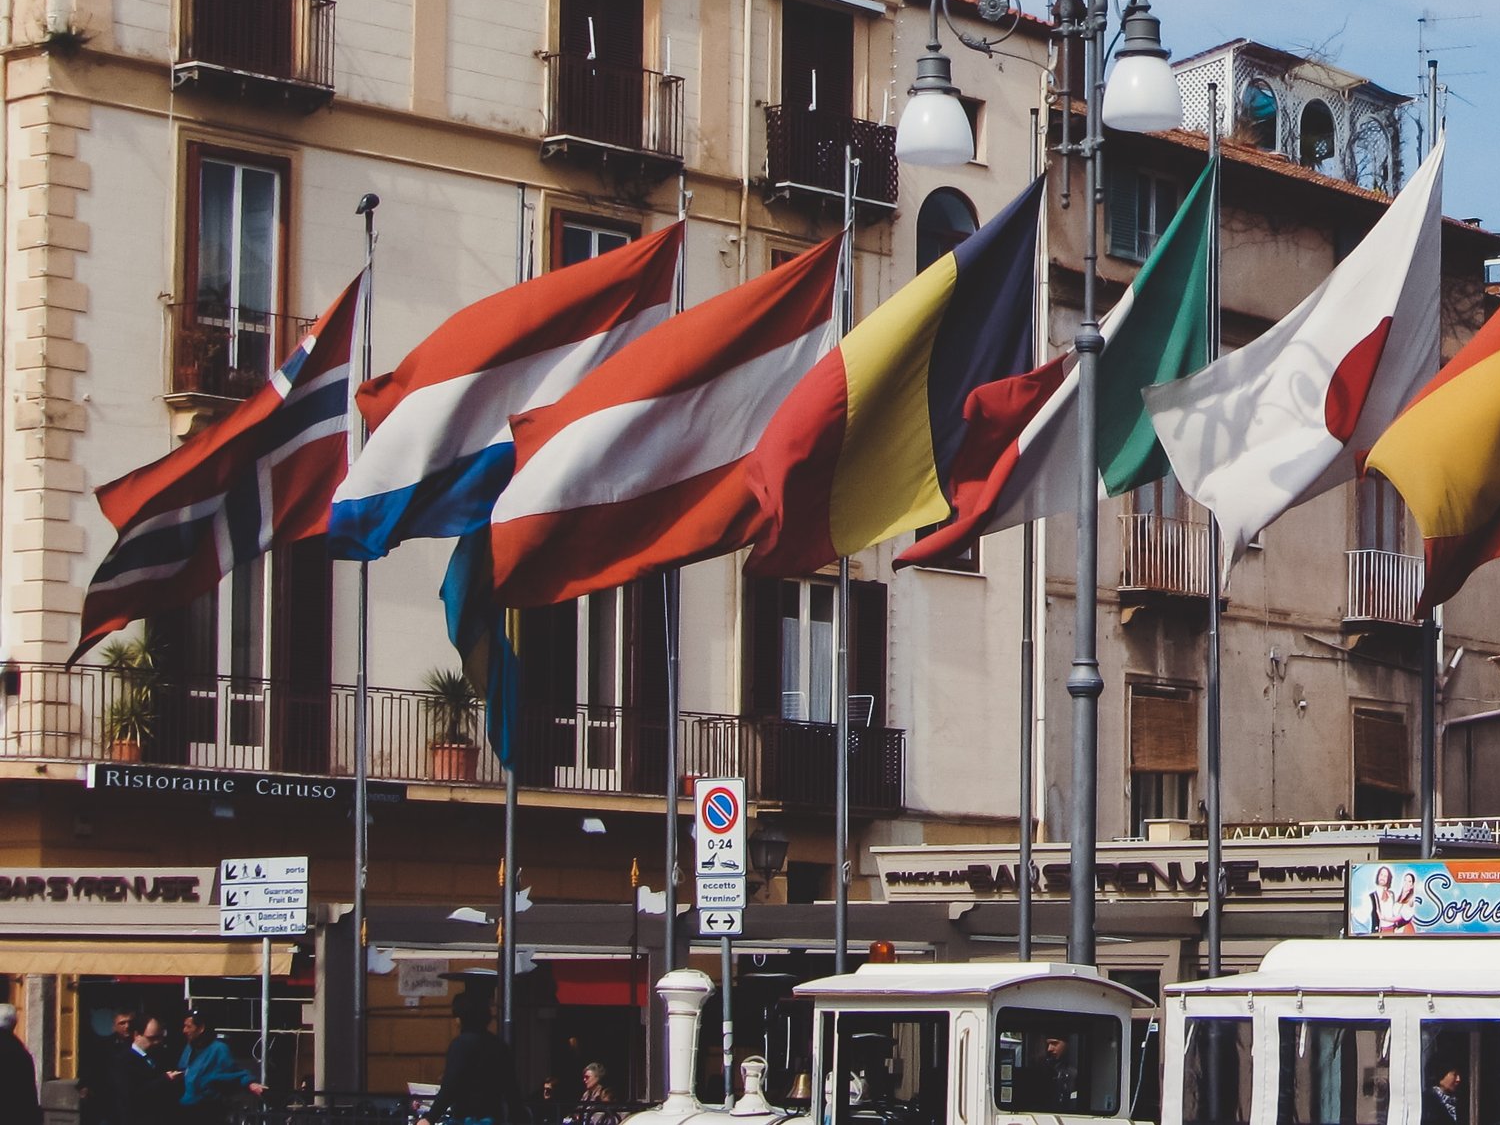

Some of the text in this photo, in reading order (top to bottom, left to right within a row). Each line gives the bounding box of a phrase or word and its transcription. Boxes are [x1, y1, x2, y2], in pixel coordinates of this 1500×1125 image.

[105, 769, 336, 799] Ristorante Caruso
[707, 838, 733, 850] 0-24
[285, 866, 305, 875] porto
[1457, 871, 1479, 880] EVERY
[702, 882, 736, 890] eccetto
[263, 887, 304, 895] Guarracino
[268, 895, 300, 904] Fruit Bar
[258, 911, 287, 921] Dancing
[258, 922, 307, 933] Karaoke Club
